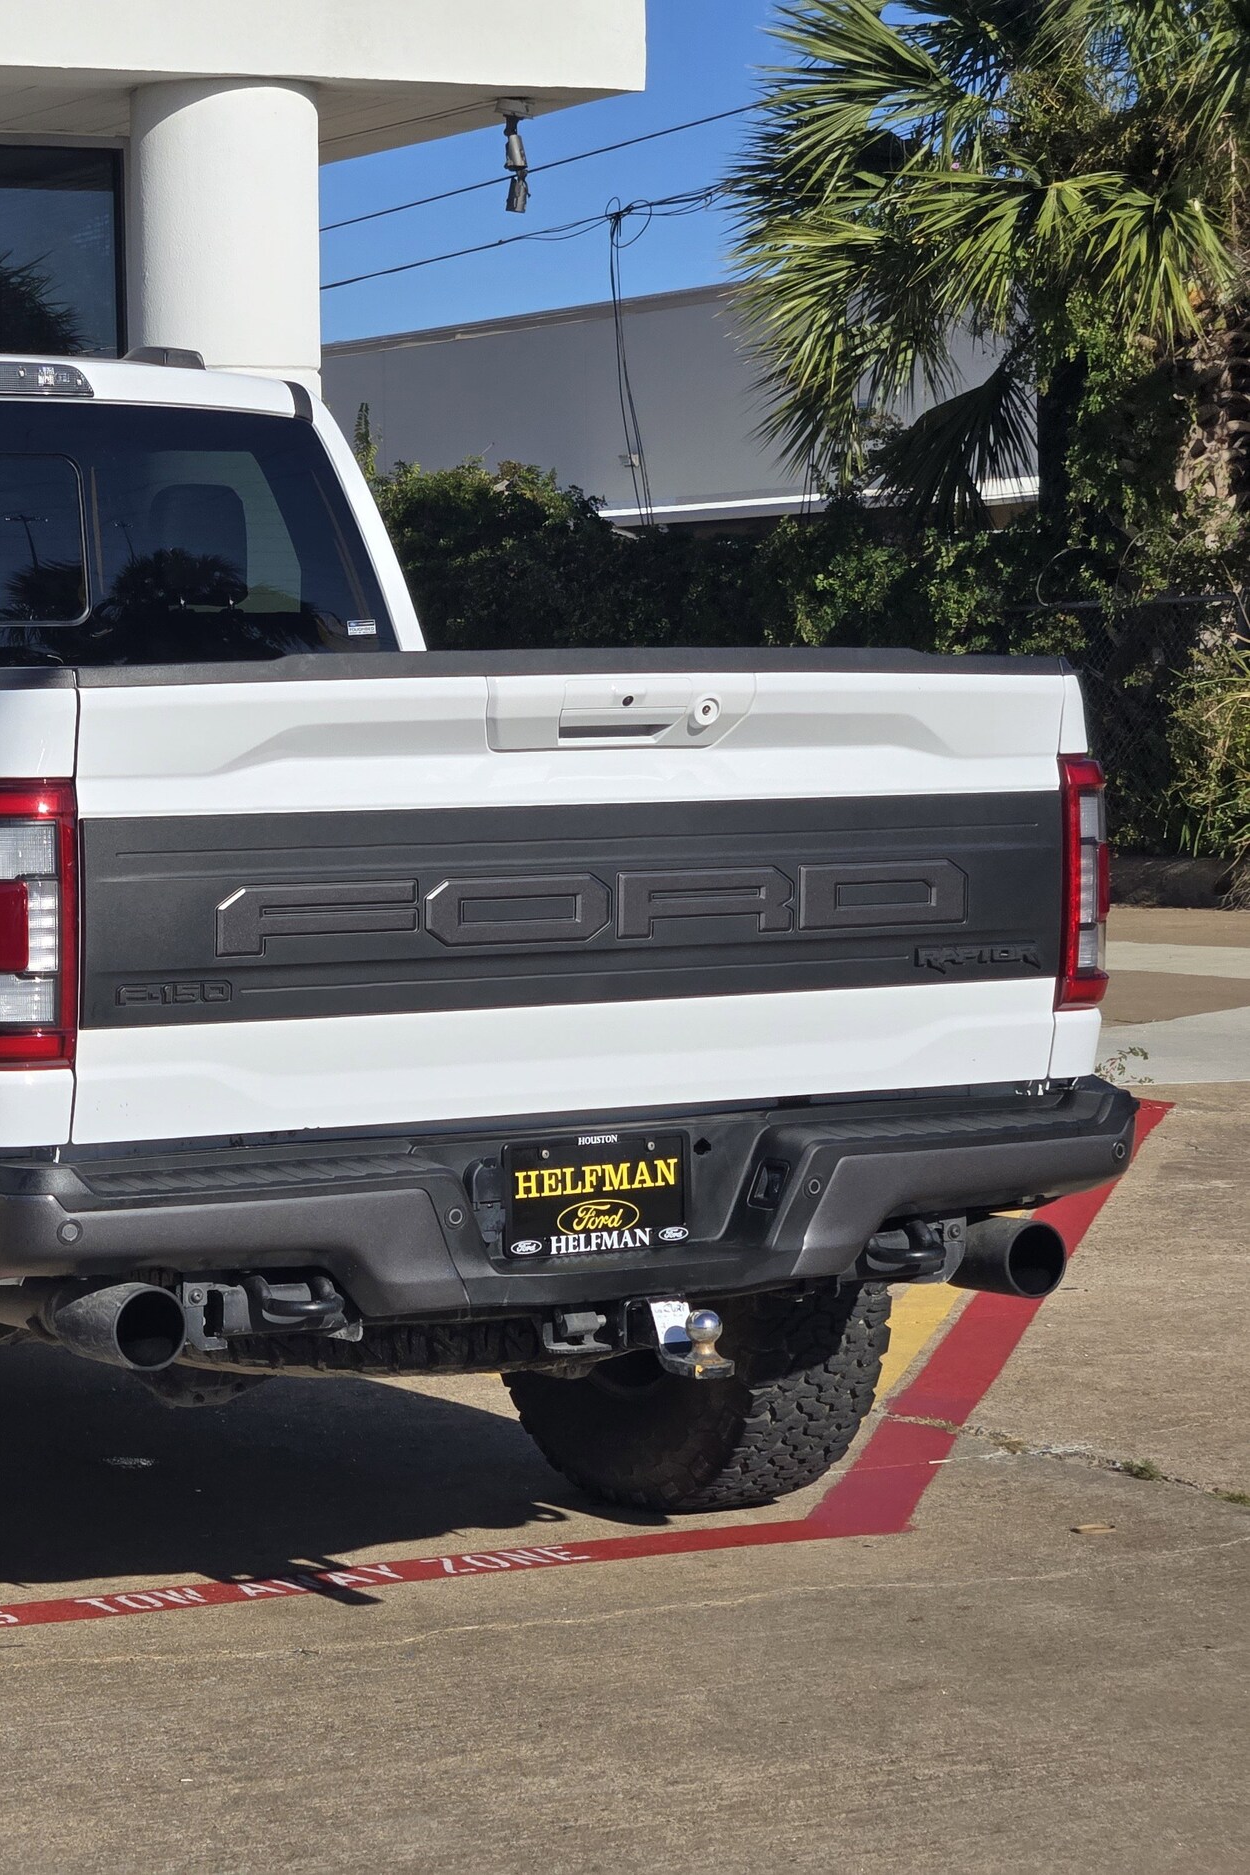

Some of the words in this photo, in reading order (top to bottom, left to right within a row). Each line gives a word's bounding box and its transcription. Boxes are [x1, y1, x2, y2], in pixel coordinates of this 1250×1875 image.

[214, 859, 967, 959] FORD
[914, 940, 1042, 975] RAPTOR
[114, 980, 233, 1007] F-150
[578, 1135, 618, 1146] HOUSTON
[515, 1158, 678, 1199] HELFMAN
[572, 1204, 623, 1231] Ford
[550, 1228, 652, 1255] HELFMAN
[665, 1228, 686, 1240] Ford
[516, 1242, 537, 1254] Ford
[74, 1587, 209, 1613] TOW
[238, 1564, 405, 1598] AWAY
[420, 1545, 591, 1574] ZONE
